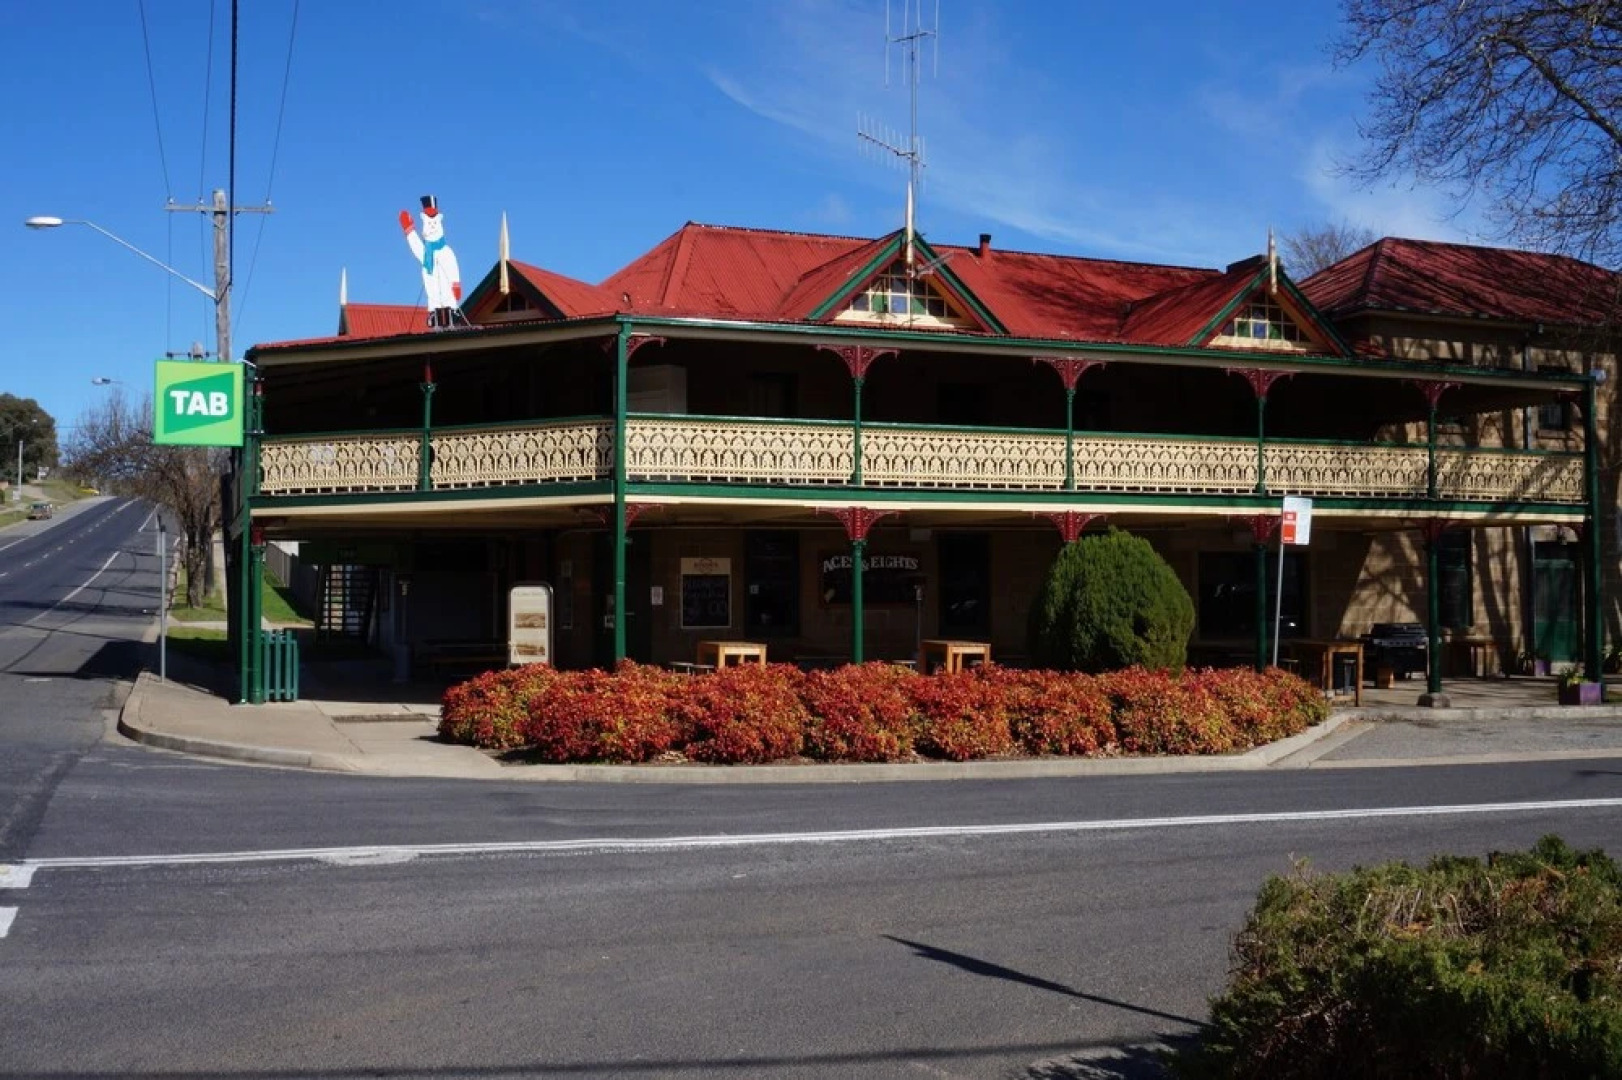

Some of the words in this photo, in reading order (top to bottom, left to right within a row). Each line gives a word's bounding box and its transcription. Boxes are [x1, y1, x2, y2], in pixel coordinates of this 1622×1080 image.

[170, 391, 228, 416] TAB
[823, 555, 853, 573] ACE
[870, 555, 919, 571] EIGHTS
